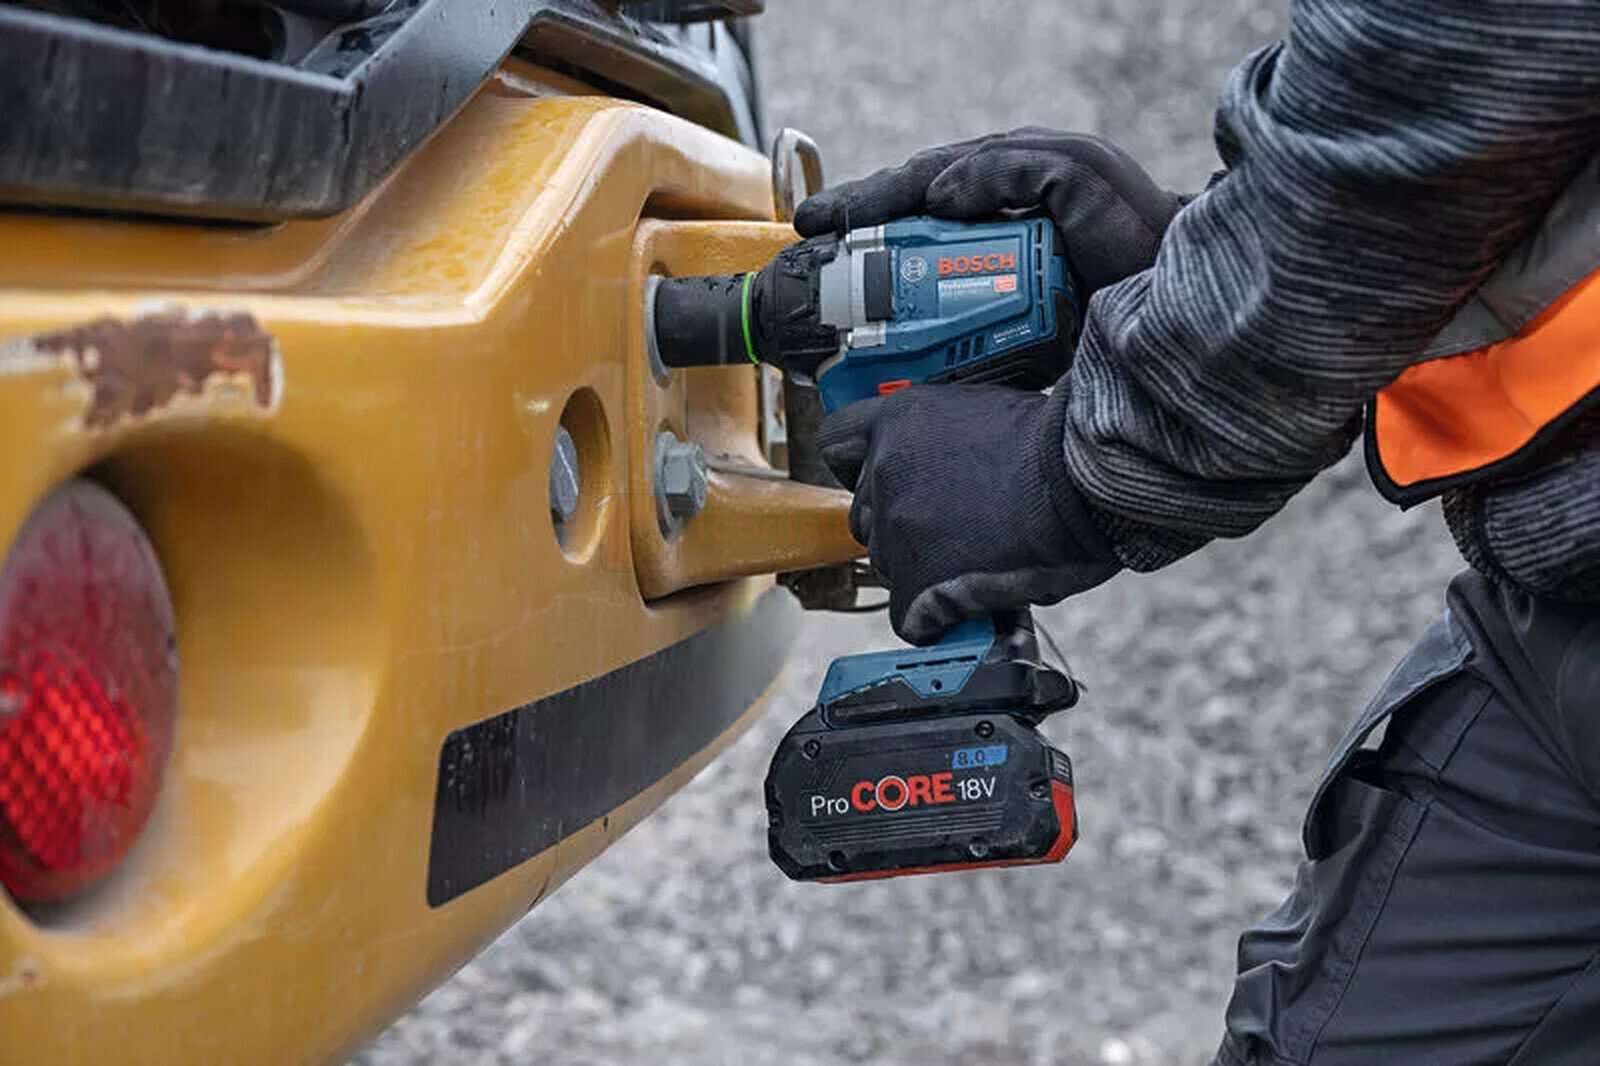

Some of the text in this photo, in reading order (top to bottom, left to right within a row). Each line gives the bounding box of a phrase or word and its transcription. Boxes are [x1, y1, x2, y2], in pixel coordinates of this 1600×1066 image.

[938, 253, 1015, 276] BOSCH
[957, 749, 985, 765] 8.0
[957, 777, 996, 801] 18V
